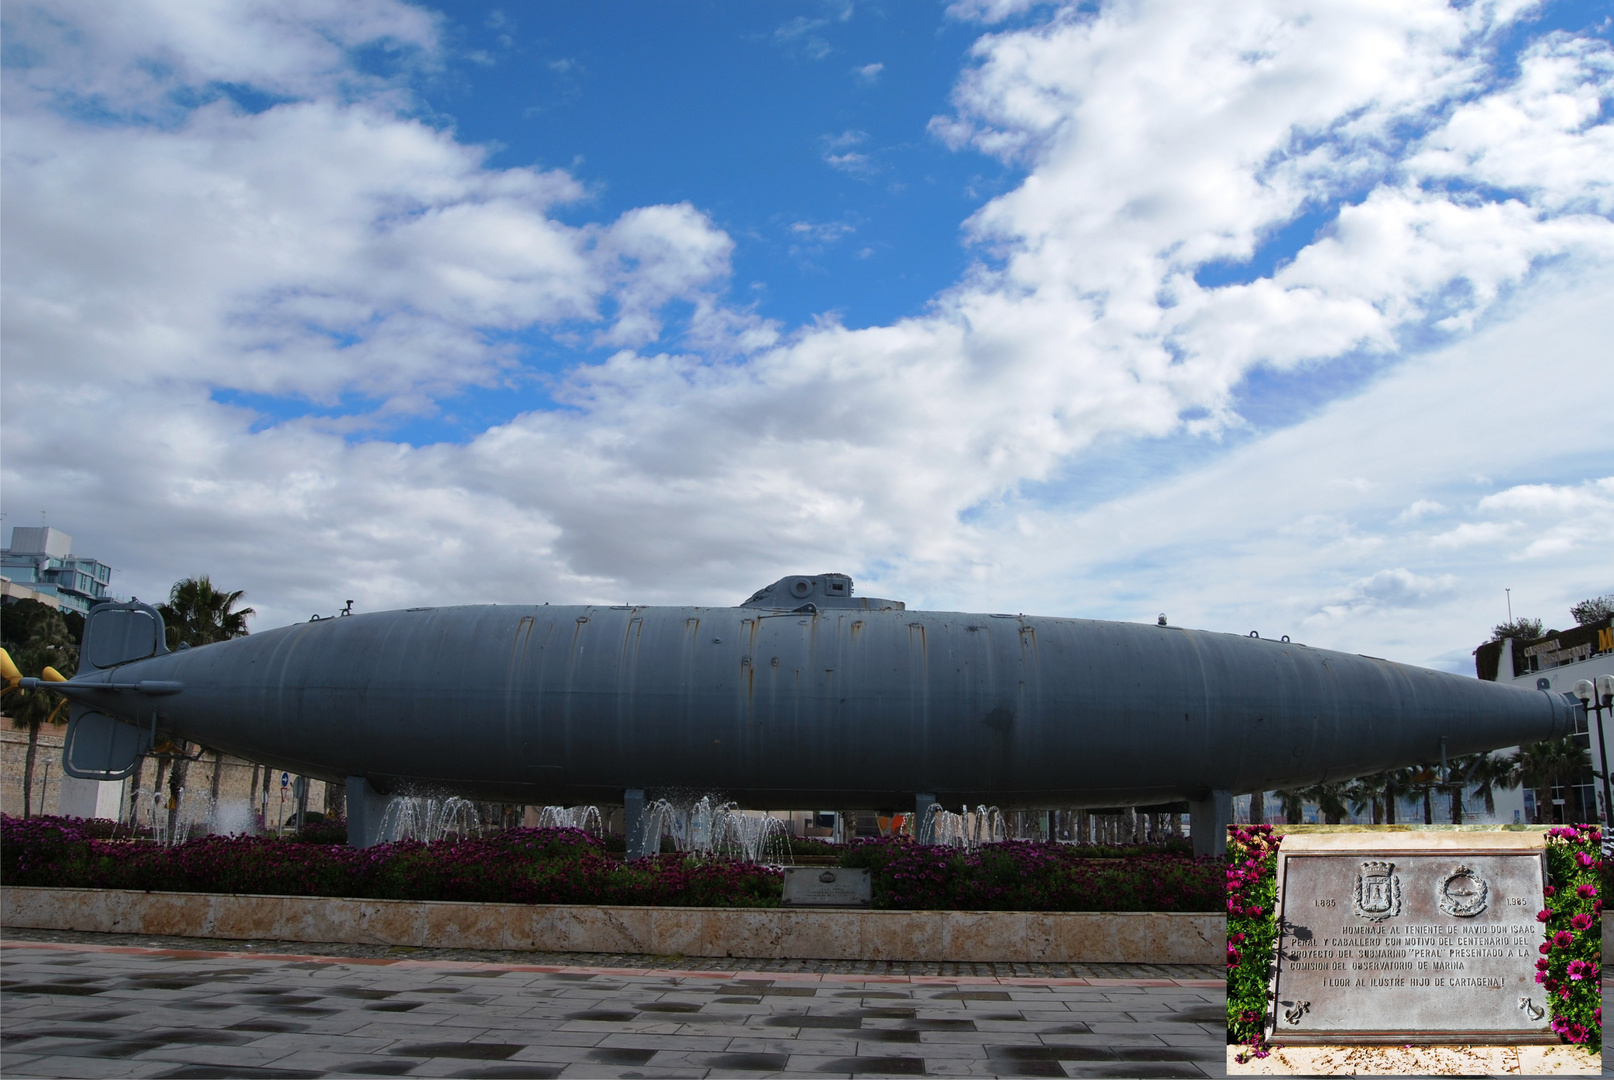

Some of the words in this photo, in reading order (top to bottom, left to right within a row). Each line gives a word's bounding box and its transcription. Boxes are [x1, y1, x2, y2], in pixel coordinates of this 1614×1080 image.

[1342, 926, 1386, 935] HOMENAJE
[1390, 926, 1400, 935] AL
[1405, 925, 1442, 935] TENIENTE
[1447, 925, 1458, 934] DE
[1462, 925, 1487, 934] NAVIO
[1491, 925, 1507, 934] DON
[1510, 925, 1535, 934] ISAAC
[1291, 938, 1318, 947] PERAL
[1323, 938, 1329, 947] Y
[1331, 938, 1381, 947] CABALLERO
[1385, 938, 1401, 947] CON
[1404, 937, 1435, 946] MOTIVO
[1438, 937, 1453, 946] DEL
[1457, 937, 1509, 946] CENTENARIO
[1513, 937, 1529, 945] DEL
[1291, 949, 1334, 958] PROYECTO
[1338, 949, 1354, 958] DEL
[1358, 949, 1406, 958] SUBMARINO
[1449, 948, 1503, 958] PRESENTADO
[1507, 948, 1514, 957] A
[1518, 948, 1530, 957] LA
[1290, 961, 1329, 971] COMISION
[1332, 961, 1347, 971] DEL
[1352, 961, 1413, 971] OBSERVATORIO
[1417, 961, 1428, 970] DE
[1432, 961, 1465, 970] MARINA
[1355, 978, 1366, 987] AL
[1370, 978, 1405, 987] ILUSTRE
[1410, 978, 1430, 987] HIJO
[1434, 978, 1445, 987] DE
